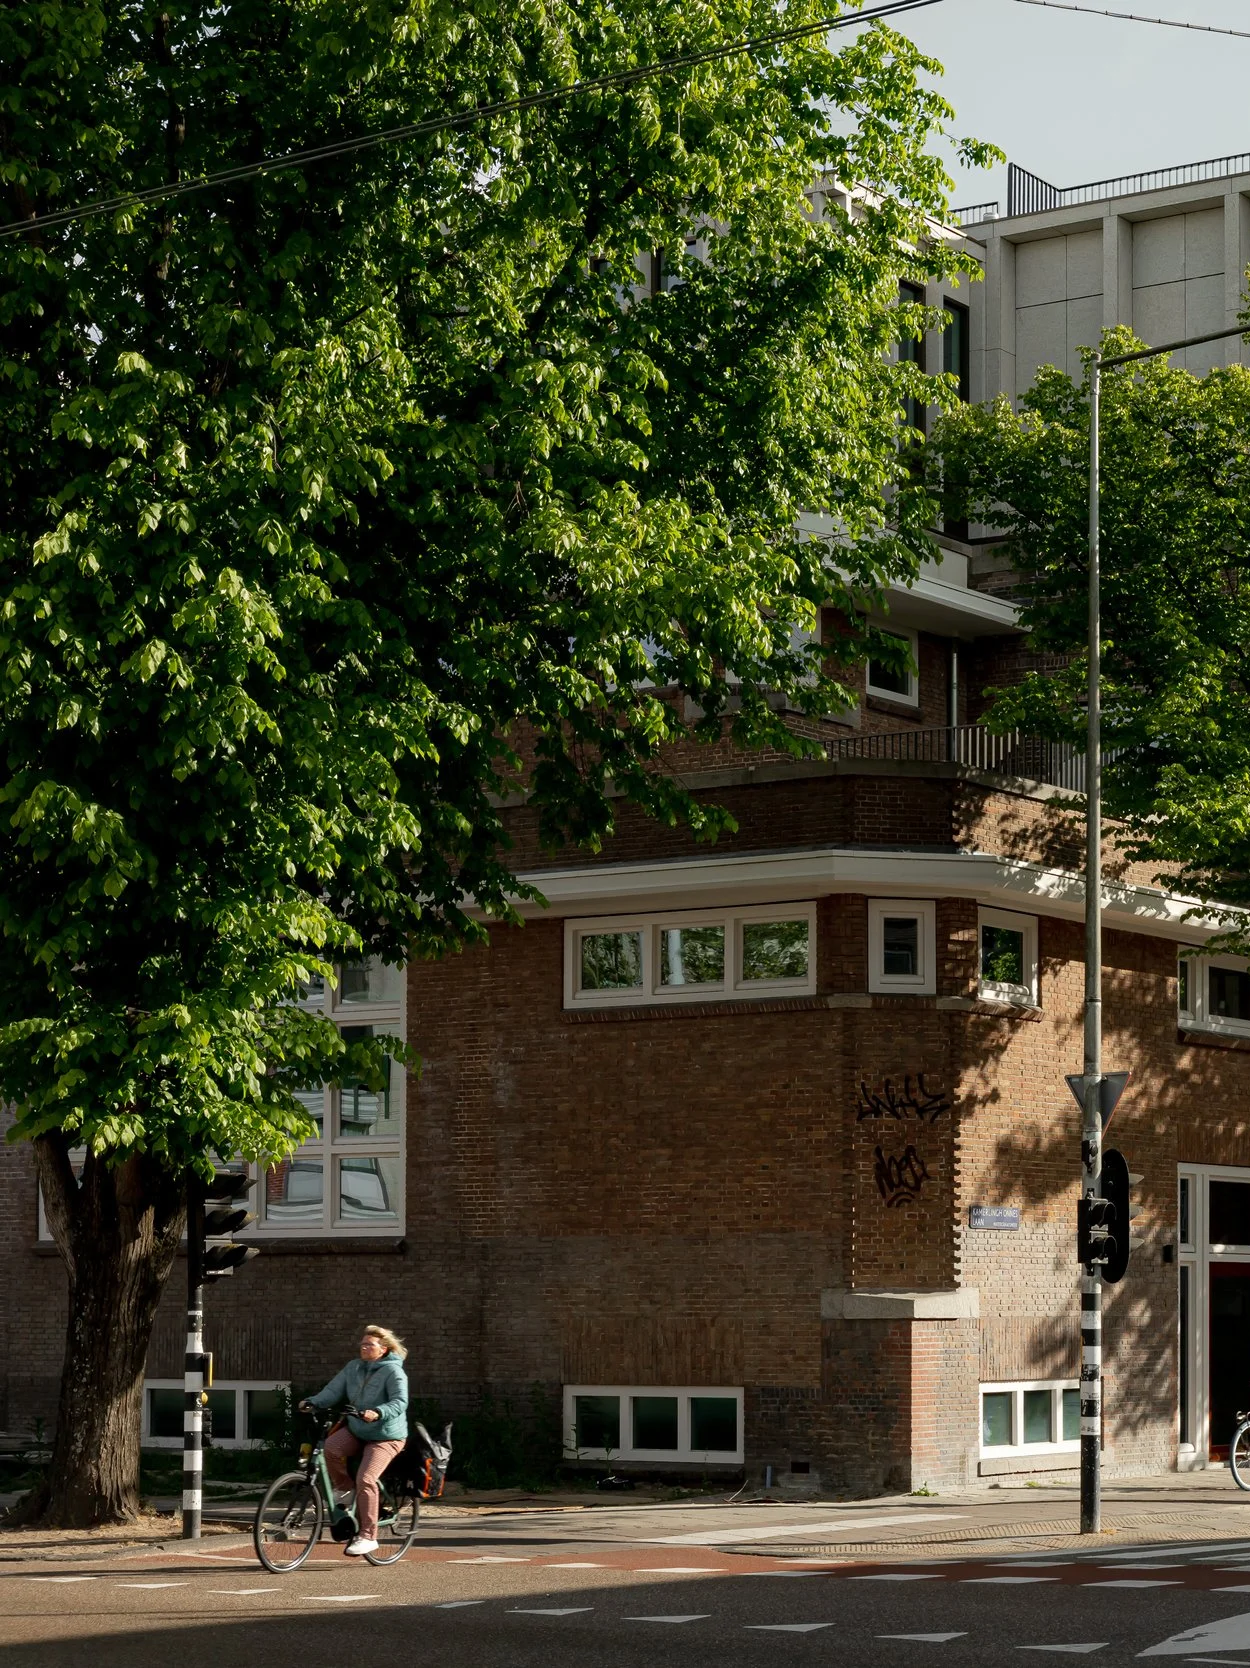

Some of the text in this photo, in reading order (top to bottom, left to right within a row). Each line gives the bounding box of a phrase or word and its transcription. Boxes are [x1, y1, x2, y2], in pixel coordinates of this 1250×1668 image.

[973, 1208, 1018, 1218] KAMERLINGH ONNES
[973, 1218, 985, 1226] LAAN
